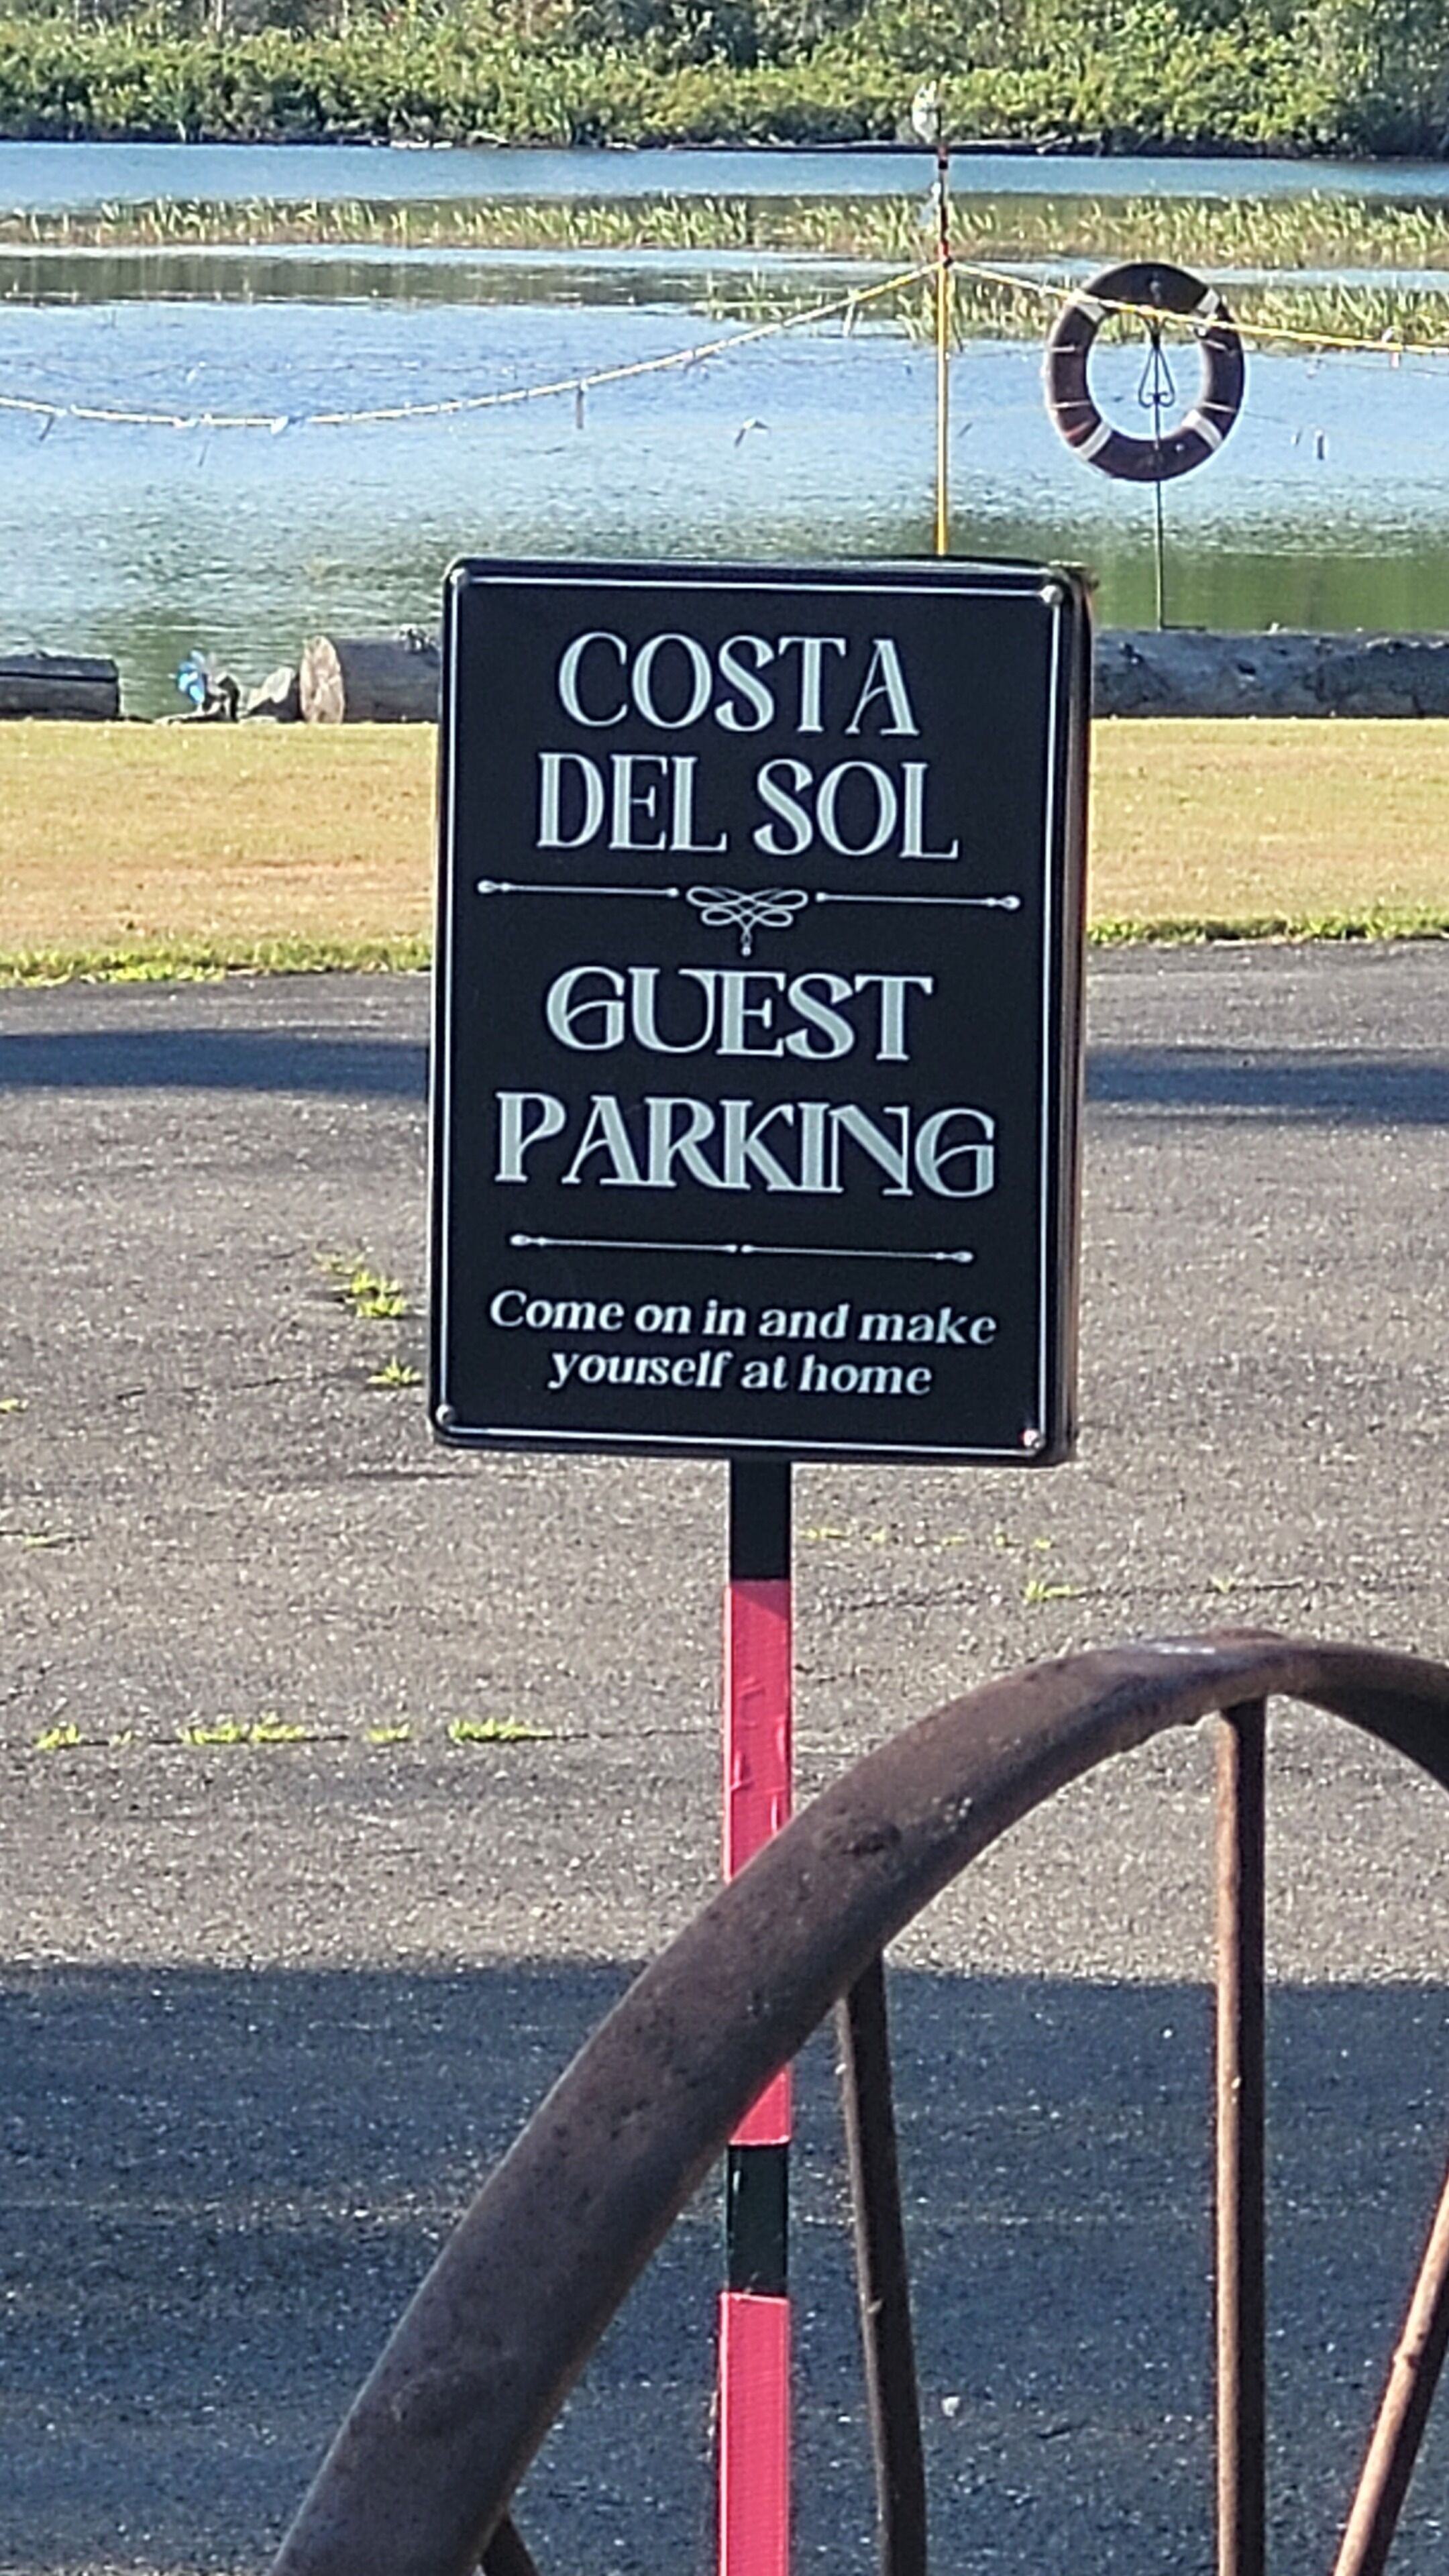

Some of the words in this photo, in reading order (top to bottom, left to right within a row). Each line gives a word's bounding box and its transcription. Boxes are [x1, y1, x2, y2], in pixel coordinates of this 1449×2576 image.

[558, 631, 919, 735] COSTA
[536, 752, 728, 851] DEL
[753, 758, 959, 859] SOL
[545, 965, 933, 1061] GUEST
[494, 1091, 995, 1197] PARKING
[490, 1289, 625, 1330] Come
[635, 1304, 692, 1334] on
[702, 1299, 747, 1336] in
[759, 1303, 850, 1339] and
[858, 1307, 997, 1344] make
[547, 1350, 734, 1389] yourself
[741, 1356, 788, 1390] at
[798, 1354, 932, 1394] home
